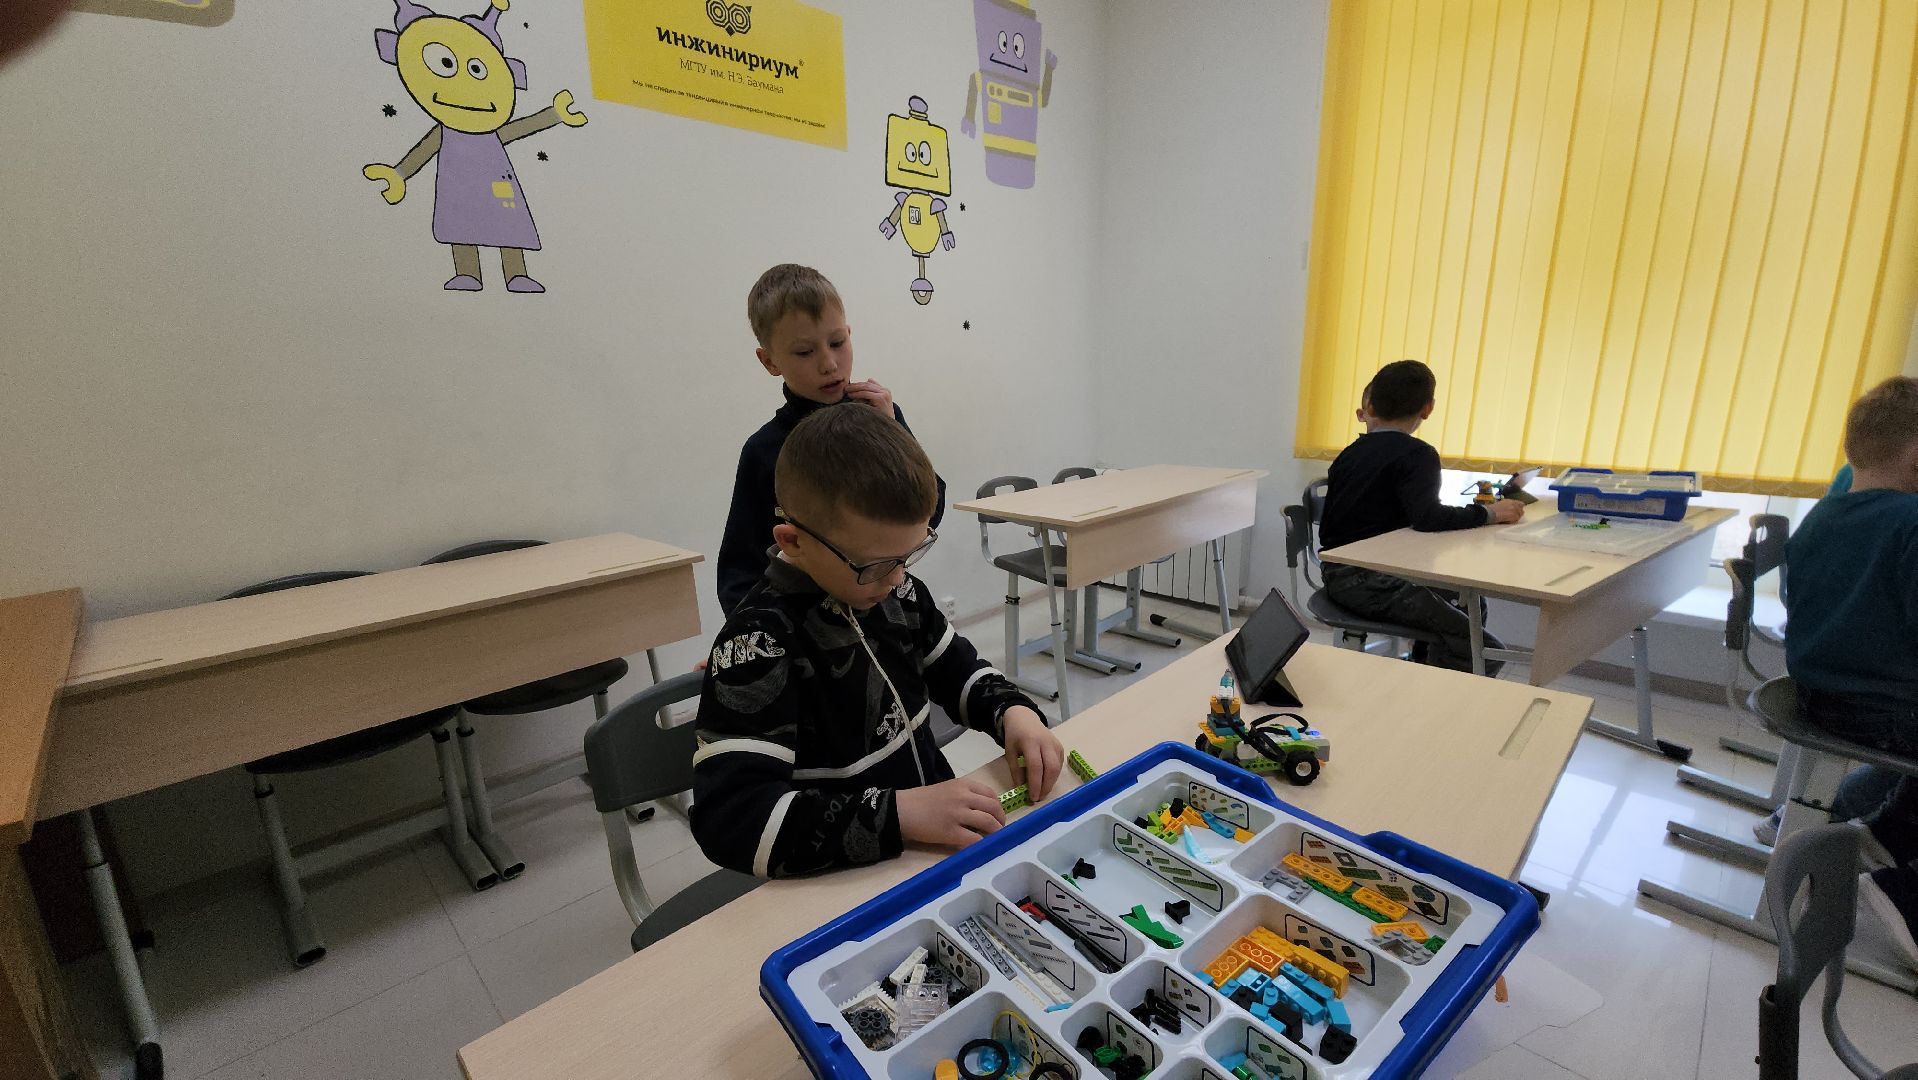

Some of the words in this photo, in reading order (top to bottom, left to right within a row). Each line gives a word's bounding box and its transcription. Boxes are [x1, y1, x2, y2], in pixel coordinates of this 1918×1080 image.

[656, 26, 799, 79] инжинириум
[679, 57, 708, 74] МГТУ
[728, 70, 745, 84] Н.Э.
[746, 75, 784, 94] Баумана
